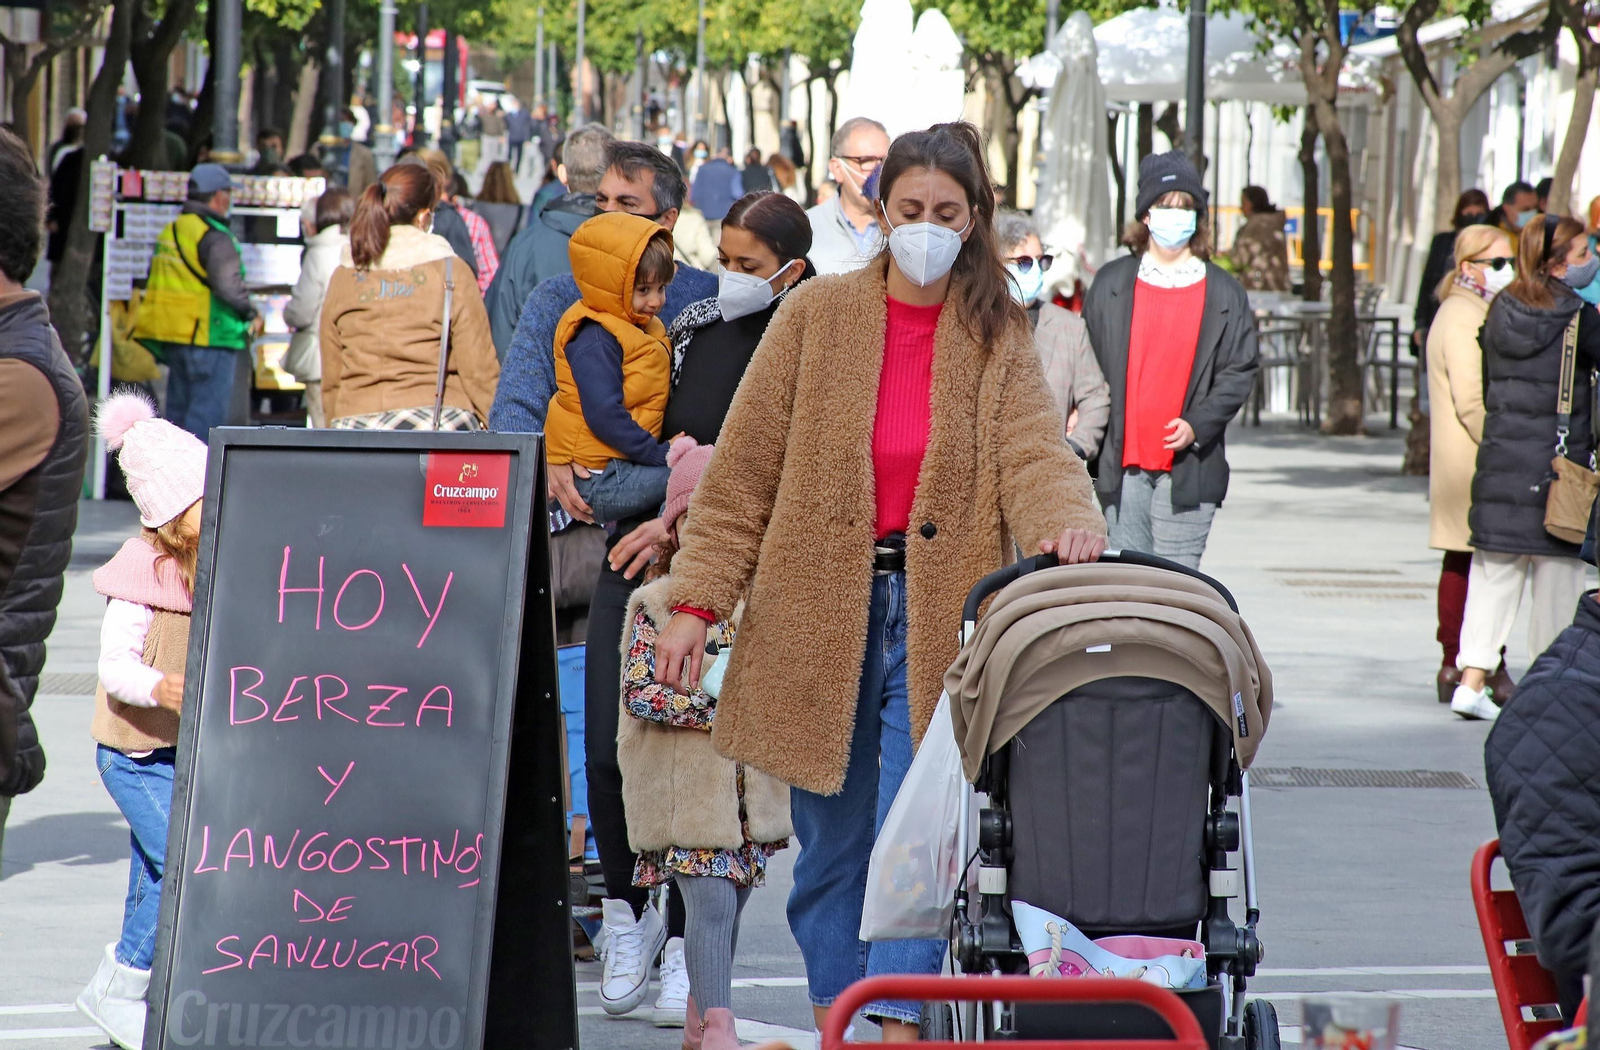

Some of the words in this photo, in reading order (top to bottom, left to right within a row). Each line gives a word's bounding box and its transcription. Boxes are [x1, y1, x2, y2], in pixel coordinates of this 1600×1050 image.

[433, 483, 499, 500] Cruzcampo
[278, 545, 454, 648] HOY
[230, 666, 453, 727] BERZA
[317, 761, 355, 804] Y
[194, 826, 483, 884] LANGOSTINOS
[293, 889, 356, 922] DE
[202, 935, 441, 980] SANLUCAR
[168, 990, 461, 1050] Cruzcampo
